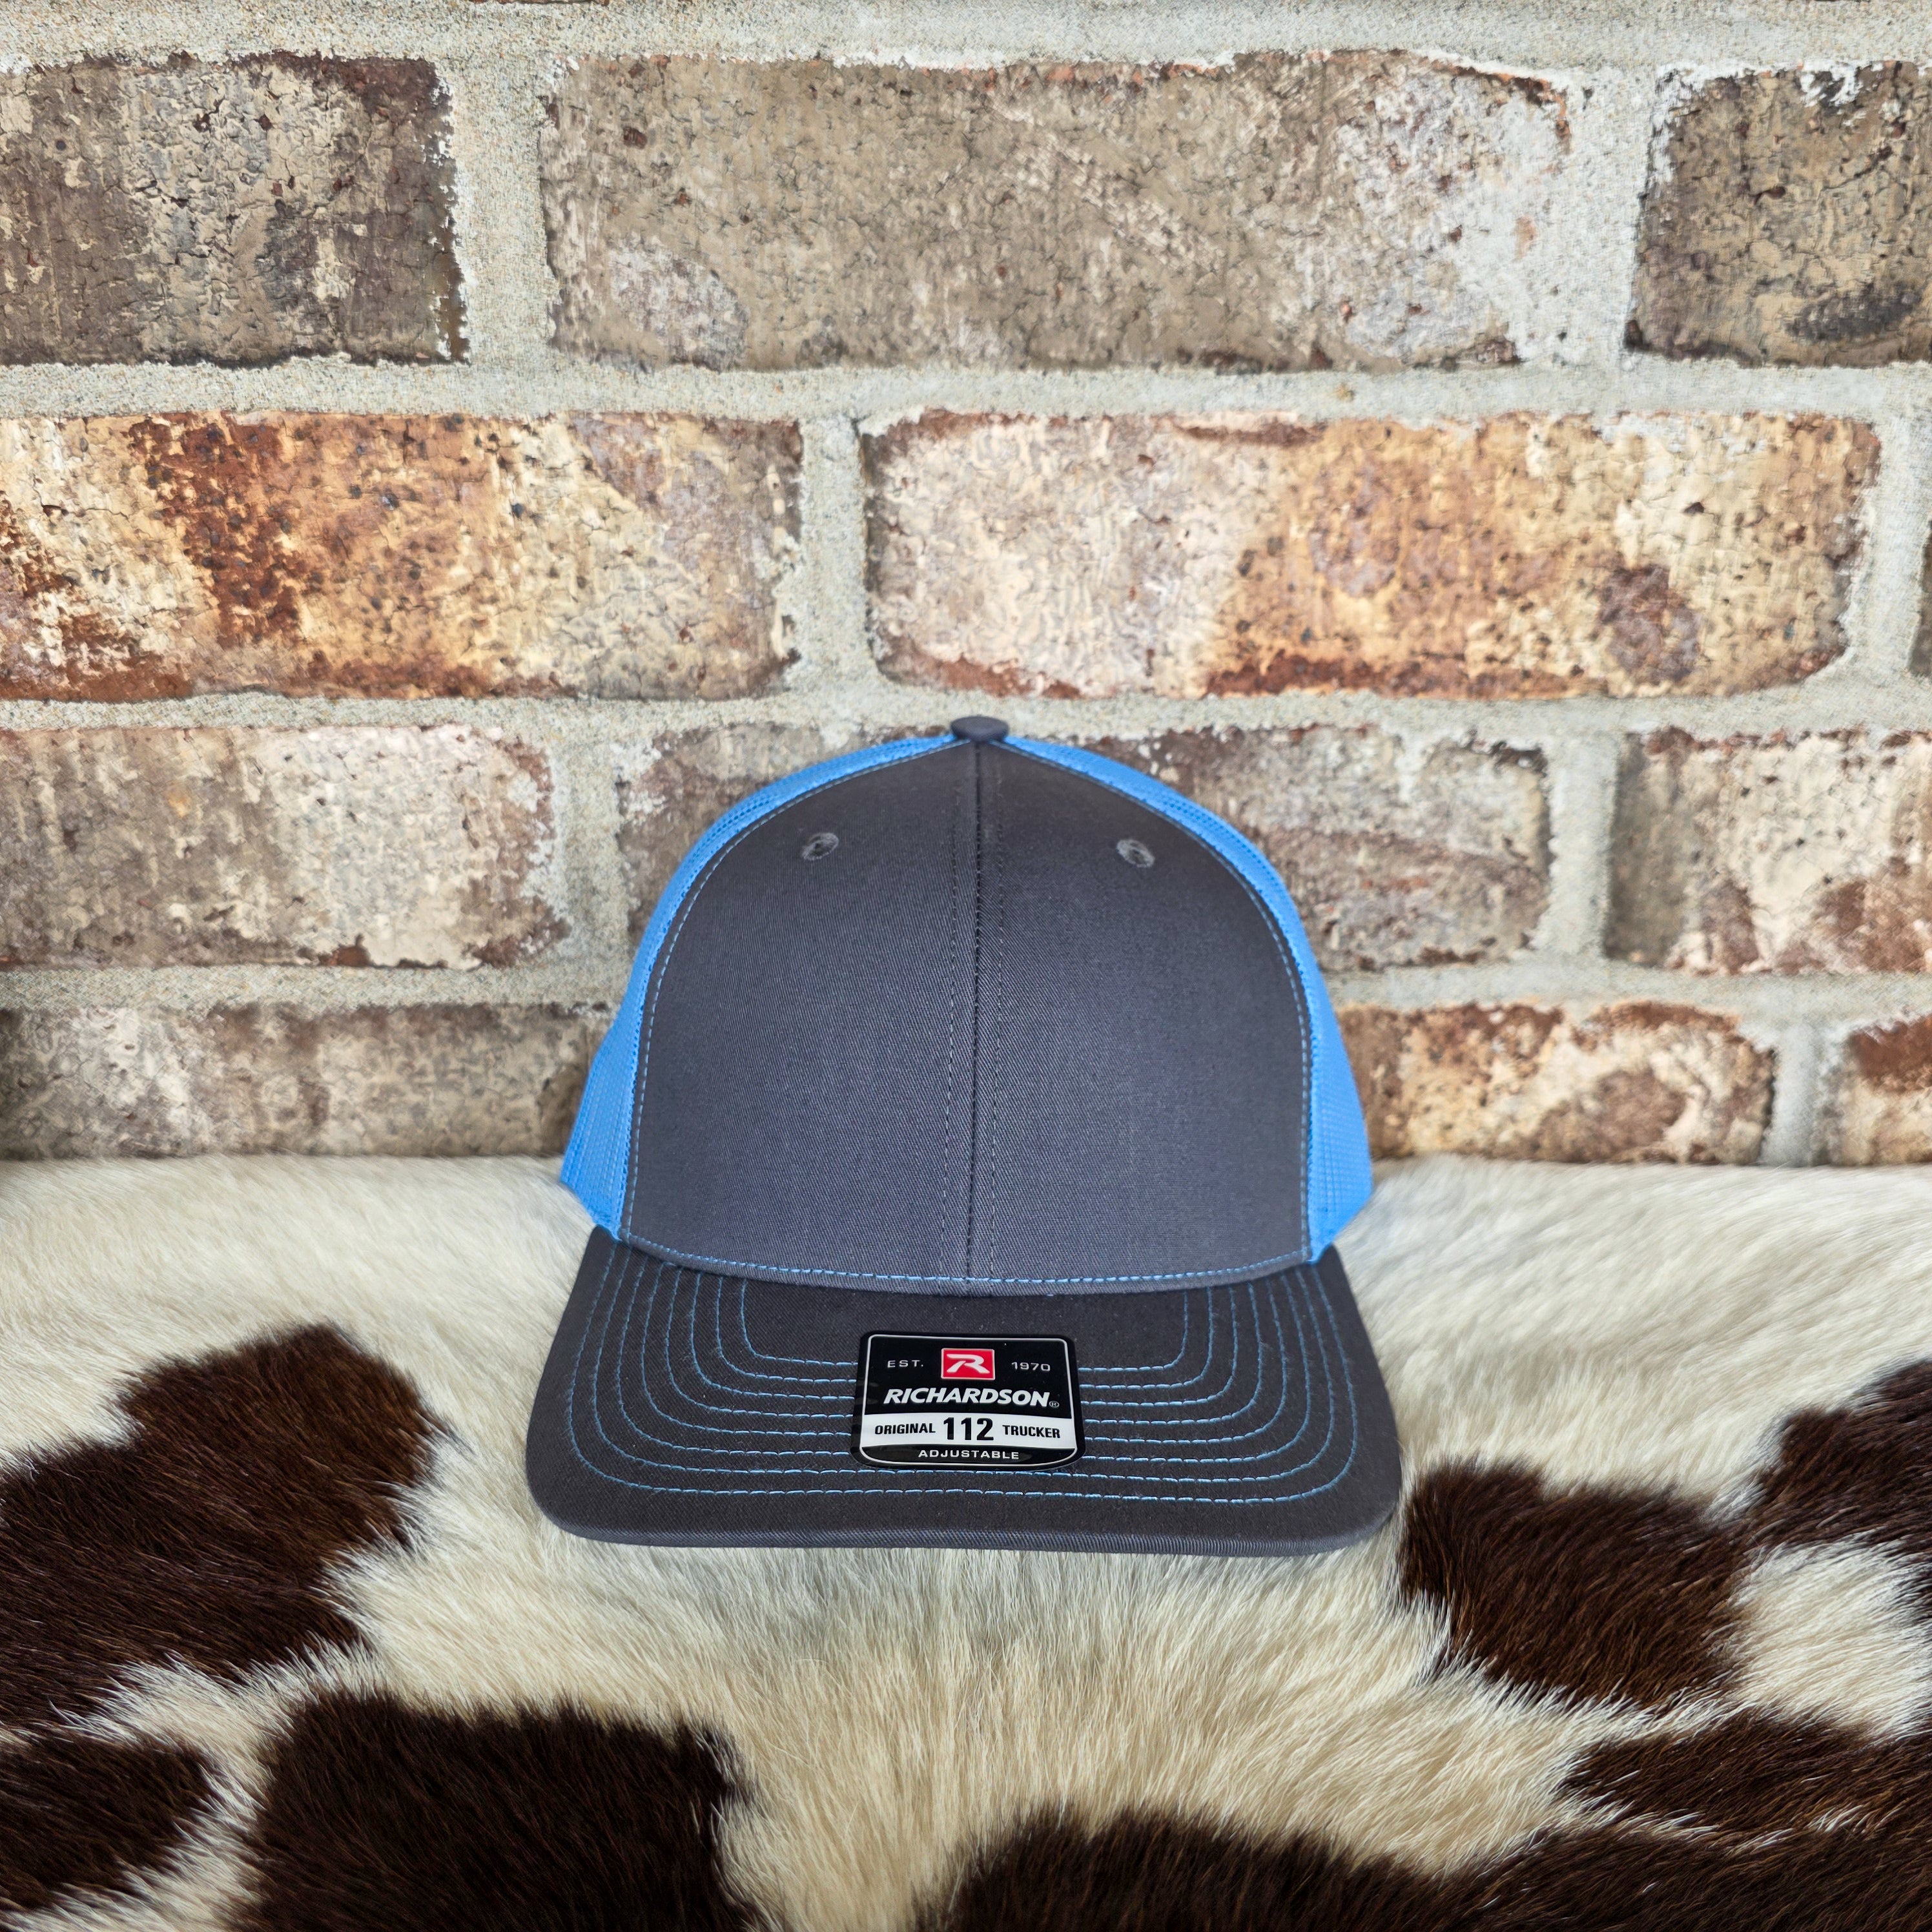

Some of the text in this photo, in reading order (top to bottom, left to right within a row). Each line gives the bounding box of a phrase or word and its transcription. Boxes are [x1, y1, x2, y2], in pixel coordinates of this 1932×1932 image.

[887, 1359, 924, 1368] EST.
[1011, 1361, 1051, 1372] 1970
[874, 1417, 1061, 1441] ORIGINAL 112 TRUCKER
[918, 1449, 1020, 1460] ADJUSTABLE
